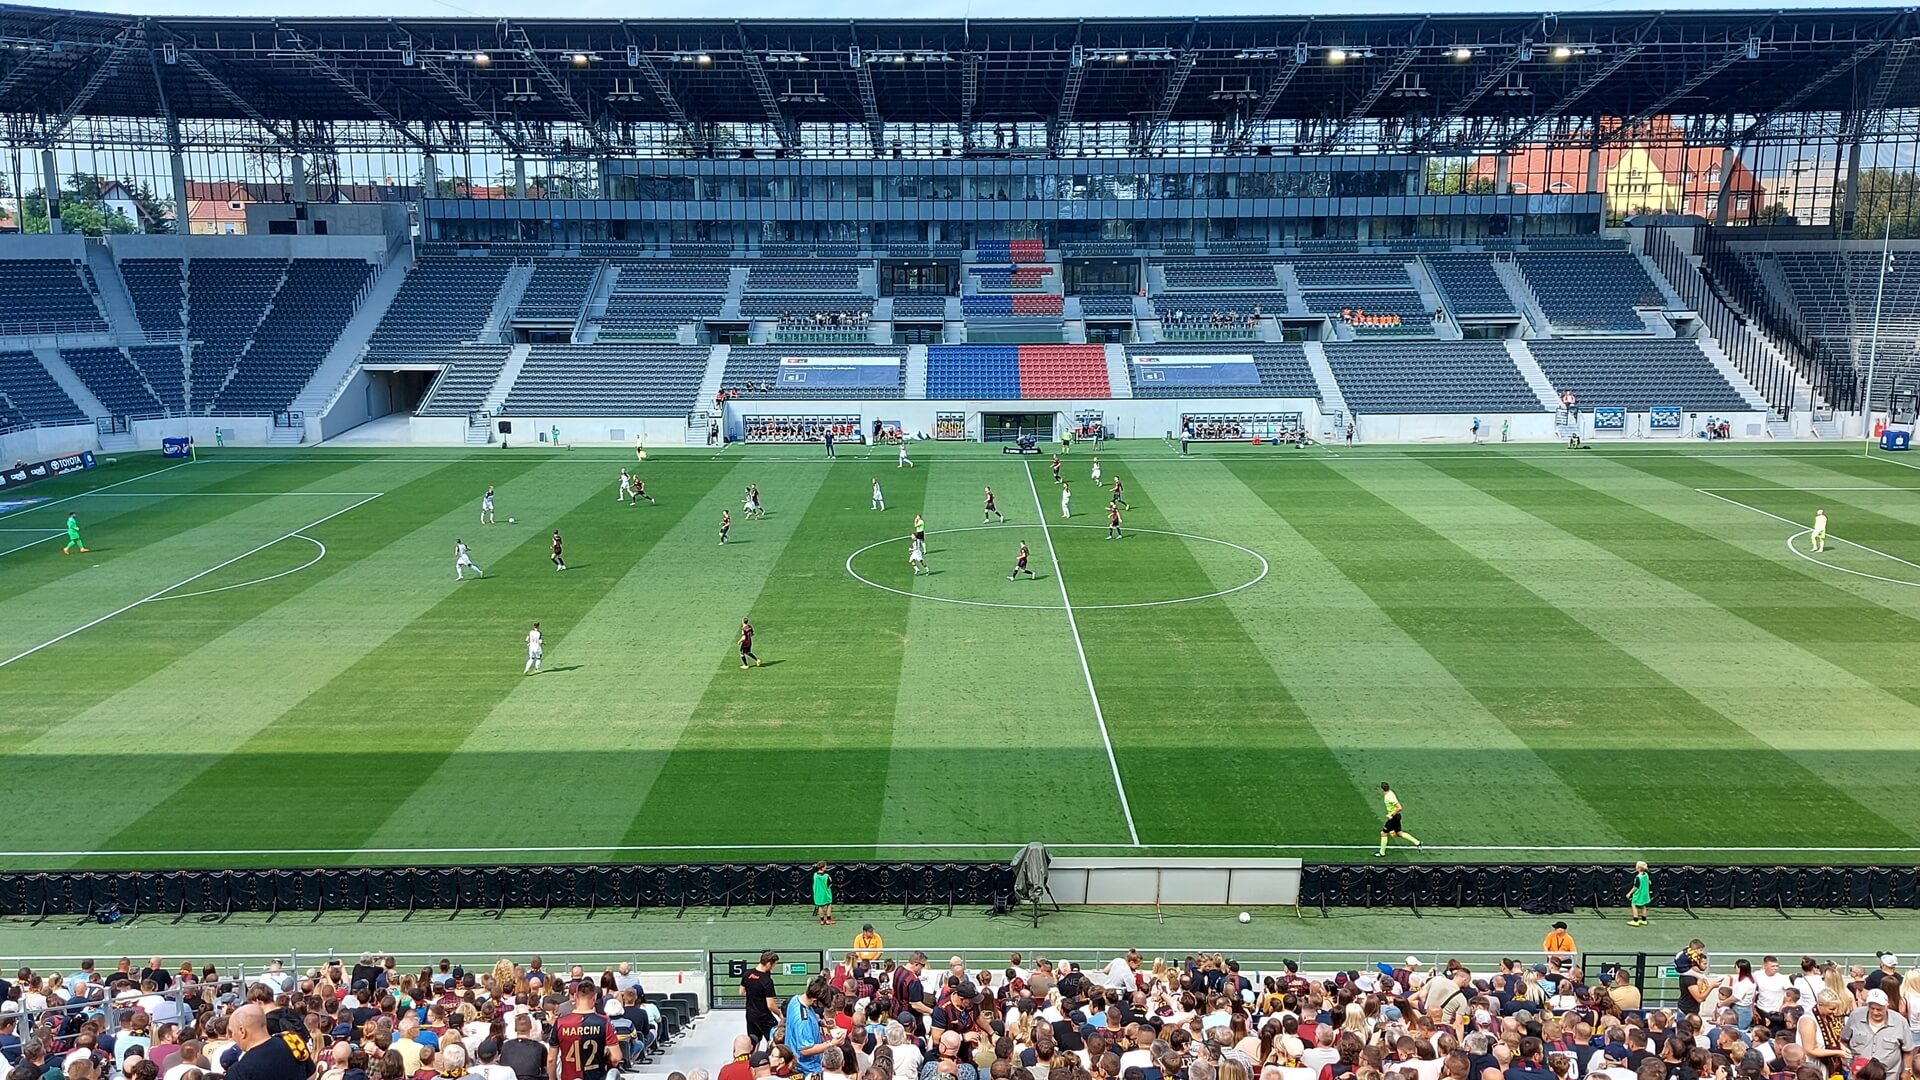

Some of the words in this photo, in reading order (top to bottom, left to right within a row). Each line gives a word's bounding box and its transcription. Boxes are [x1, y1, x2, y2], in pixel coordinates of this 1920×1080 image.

[59, 455, 82, 468] TOYOTA
[733, 964, 742, 975] 5
[1607, 967, 1616, 978] 4
[562, 1025, 600, 1036] MARCIN
[565, 1039, 599, 1072] 42
